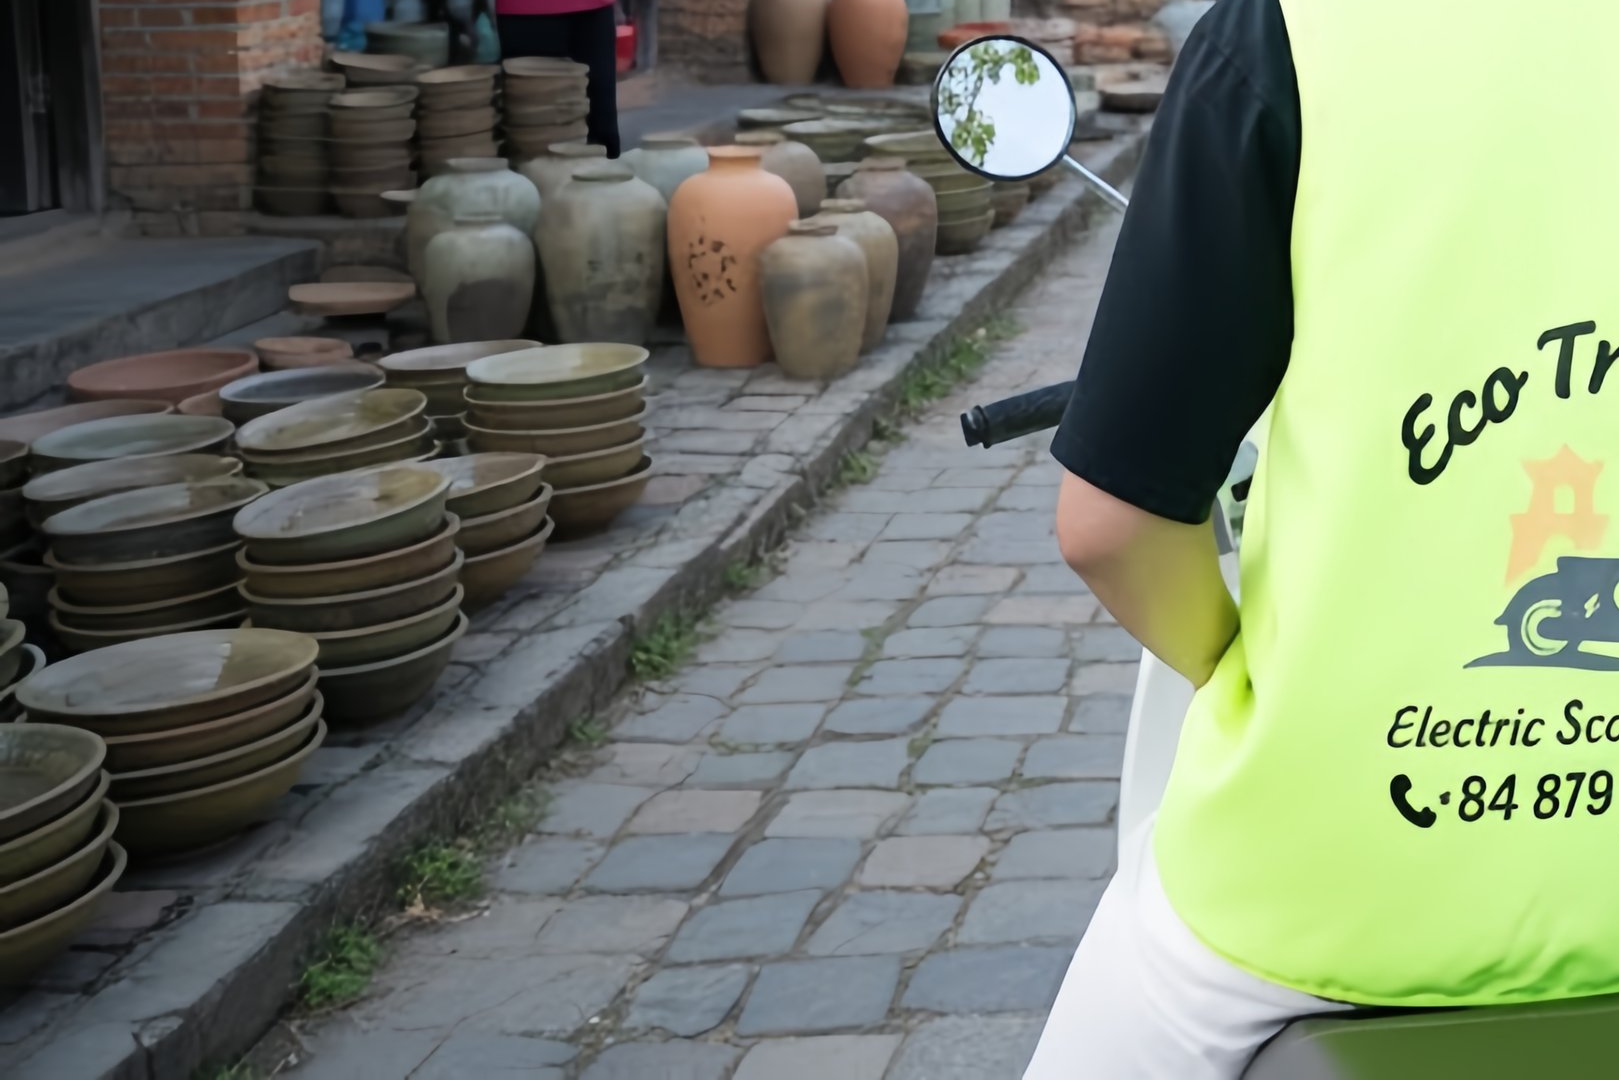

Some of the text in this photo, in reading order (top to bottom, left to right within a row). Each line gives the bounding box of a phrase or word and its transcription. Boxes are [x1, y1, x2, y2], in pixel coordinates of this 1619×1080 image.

[1401, 366, 1529, 485] Eco
[1387, 706, 1545, 749] Electric
[1533, 770, 1613, 819] 879
